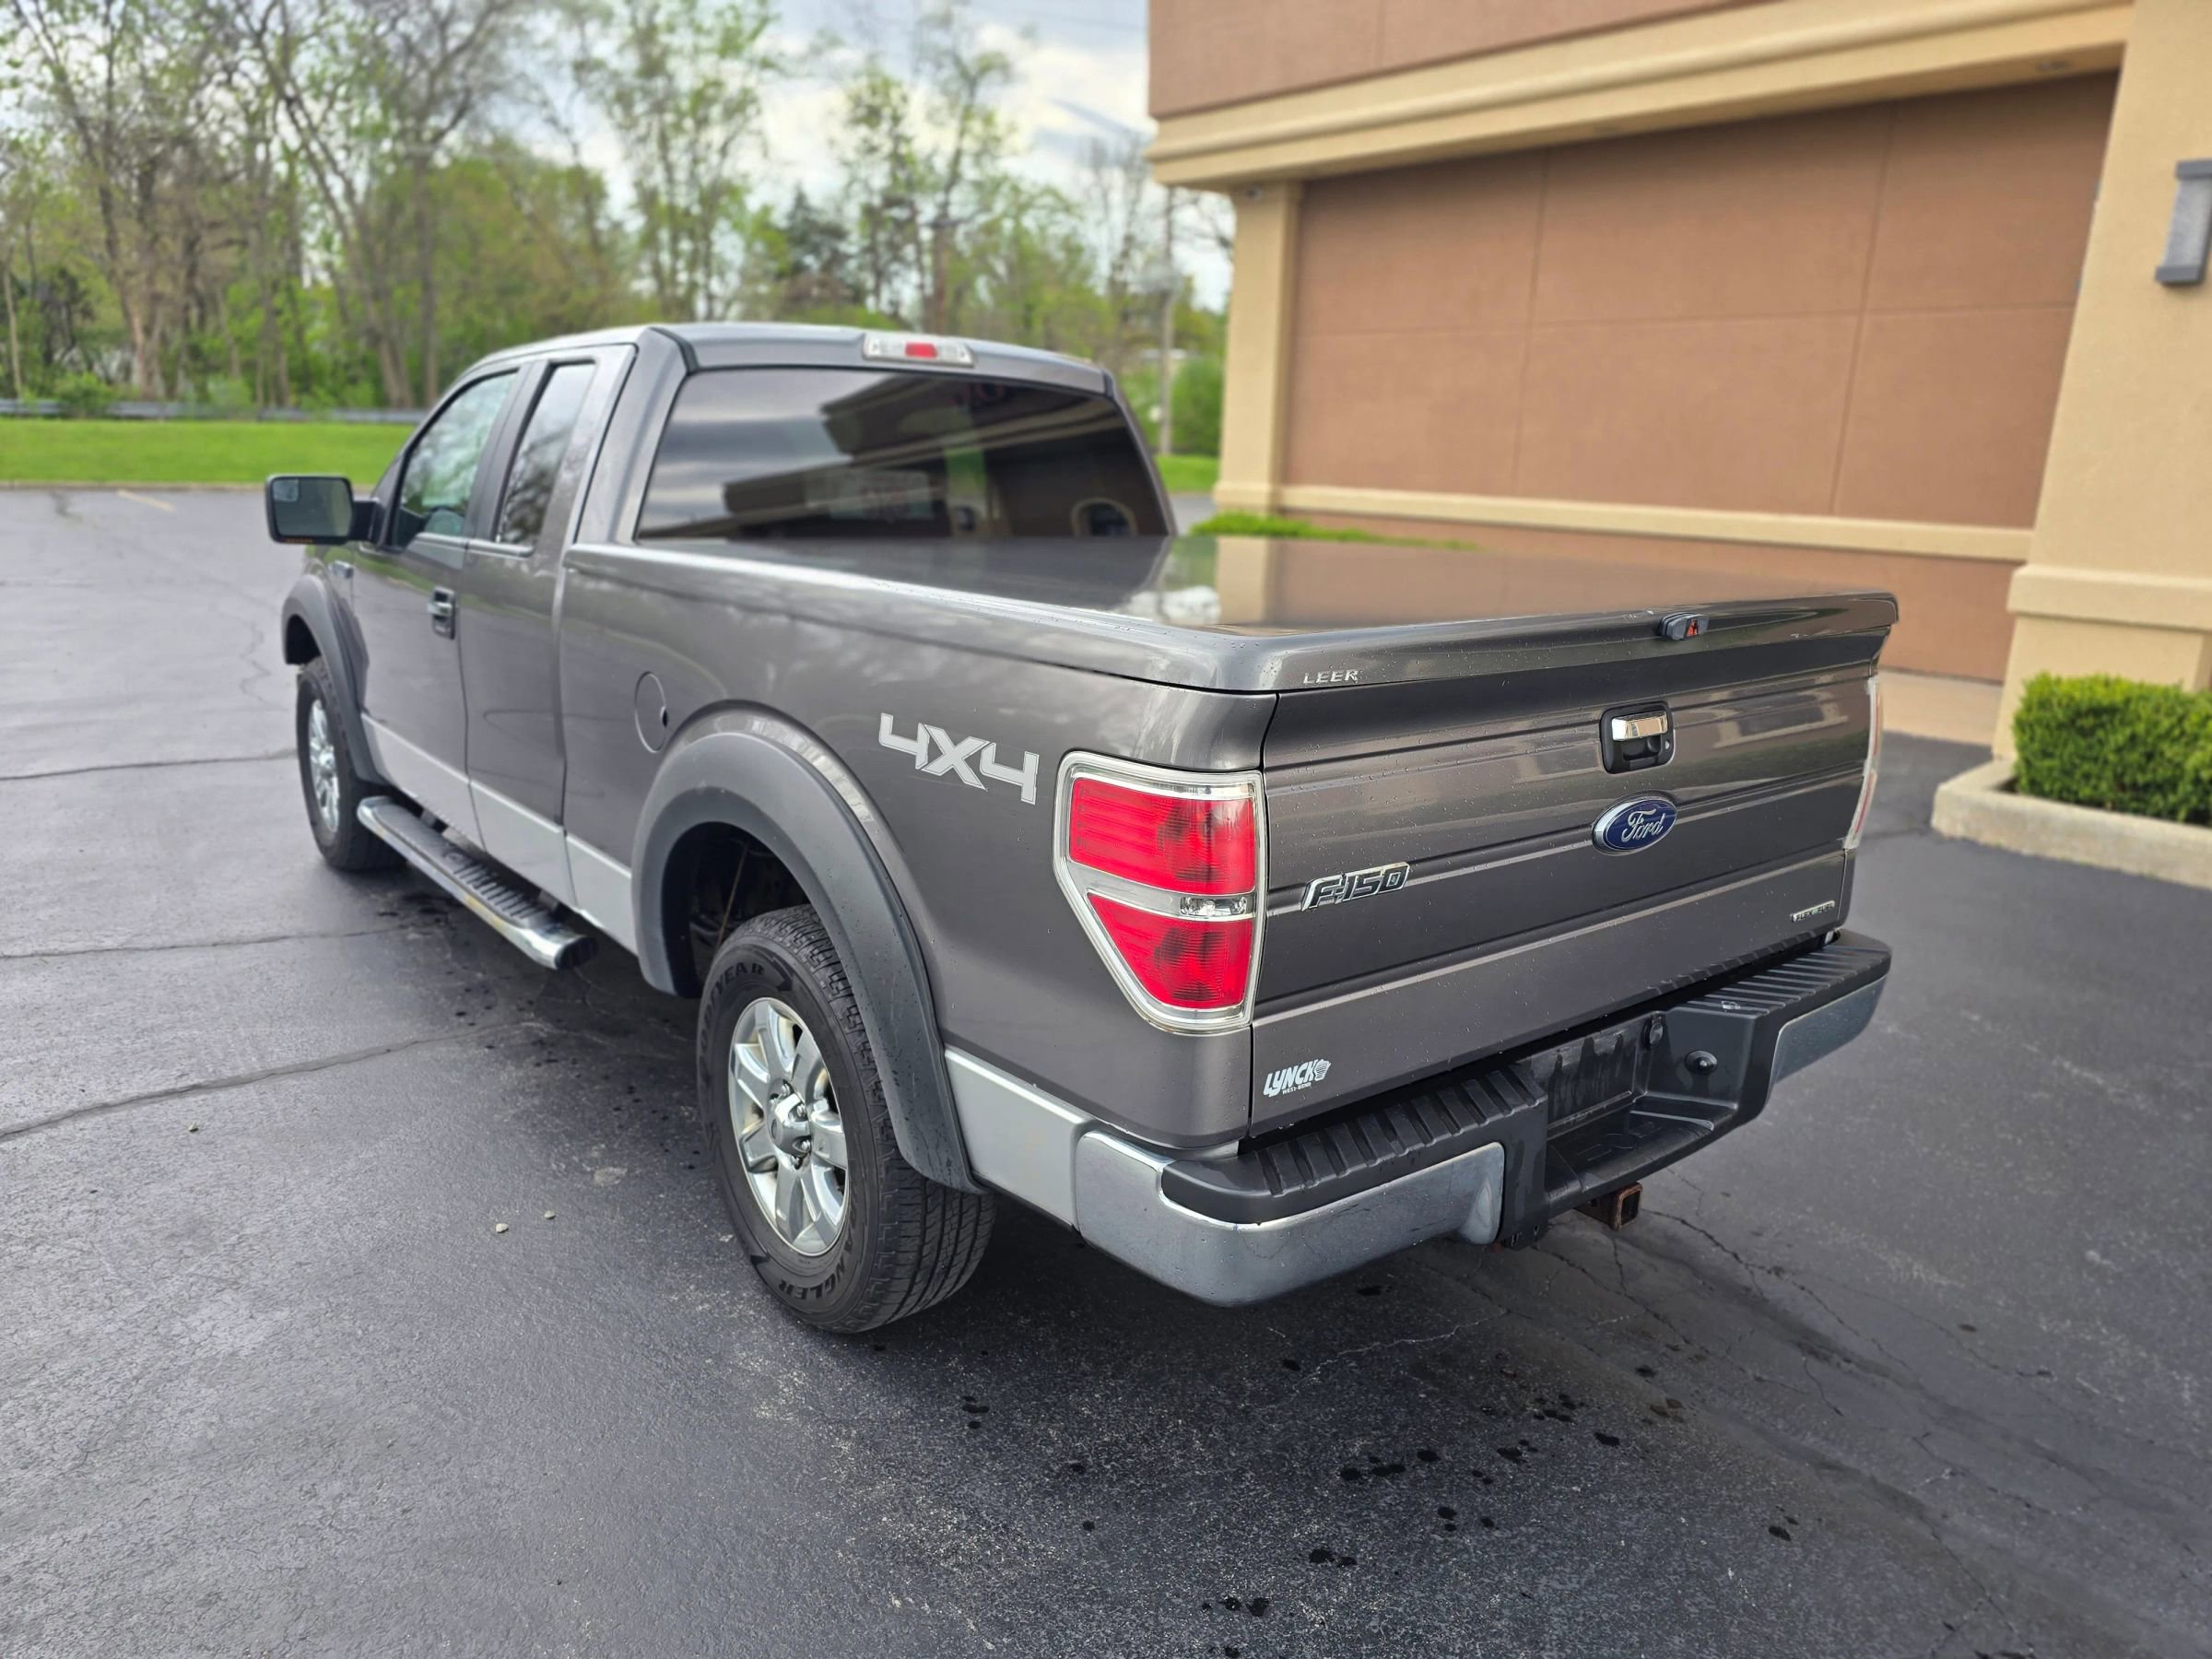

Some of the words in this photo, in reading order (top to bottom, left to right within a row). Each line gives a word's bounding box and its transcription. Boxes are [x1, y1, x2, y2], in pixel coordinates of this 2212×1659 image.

[1303, 669, 1359, 683] LEER
[879, 712, 1040, 805] 4X4
[1621, 808, 1666, 842] Ford
